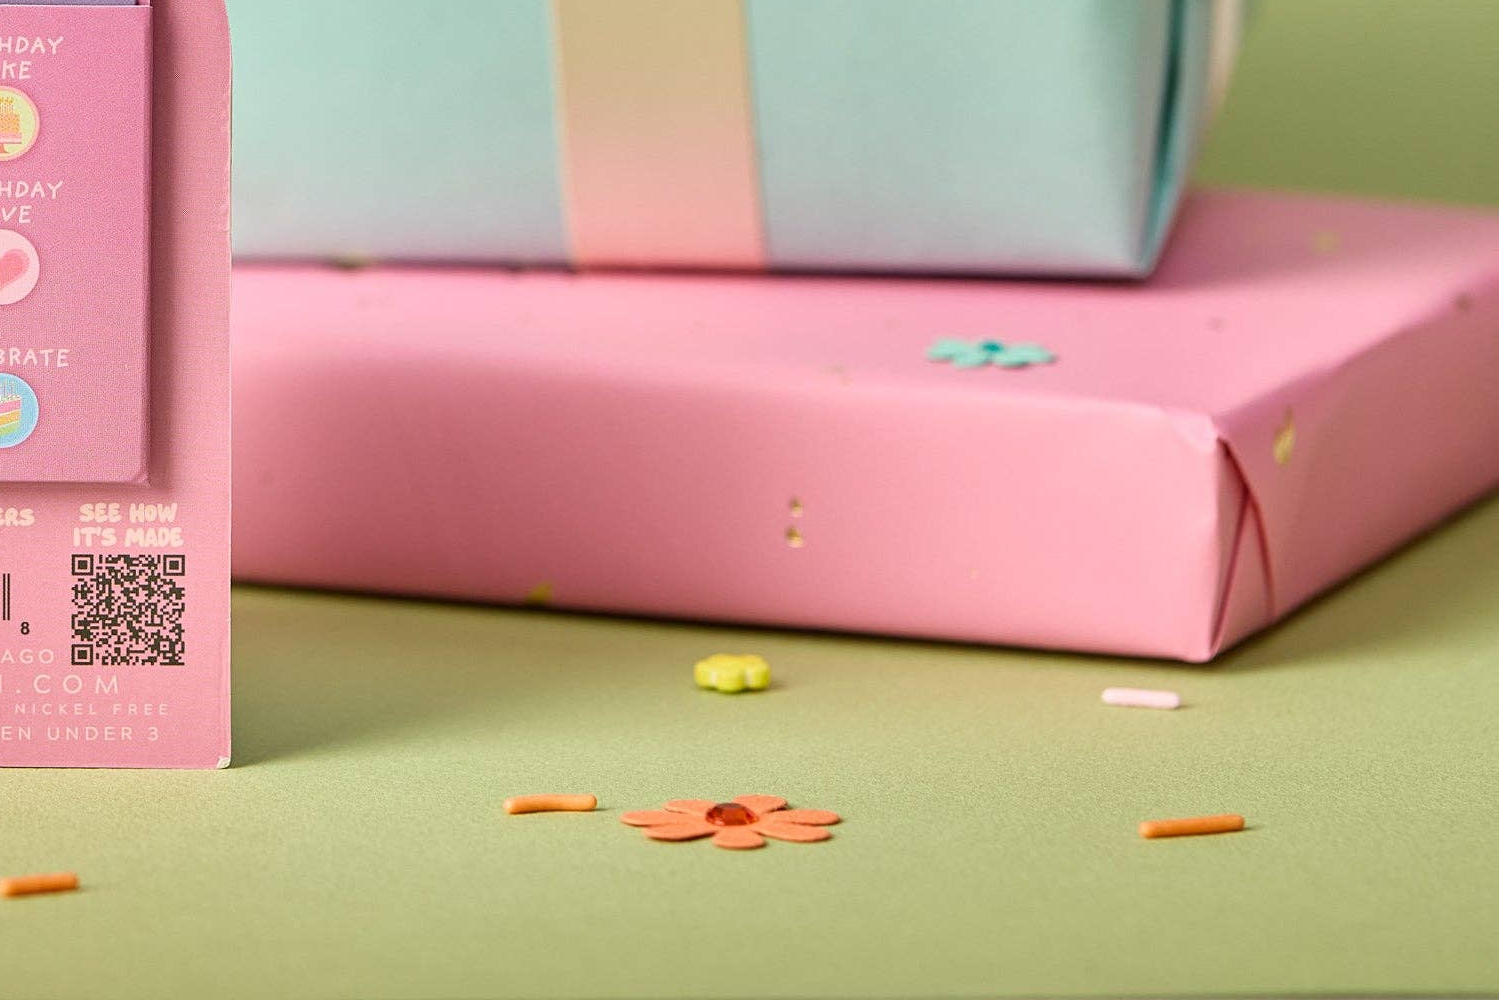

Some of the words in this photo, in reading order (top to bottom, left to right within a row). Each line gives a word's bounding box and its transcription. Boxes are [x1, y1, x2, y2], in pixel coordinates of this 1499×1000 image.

[79, 503, 121, 523] SEE
[129, 503, 178, 523] HOW
[73, 527, 118, 547] IT'S
[125, 527, 183, 548] MADE
[20, 622, 30, 635] 8
[14, 703, 100, 716] NICKEL
[114, 703, 169, 716] FREE
[47, 726, 132, 741] UNDER
[146, 727, 159, 741] 3
